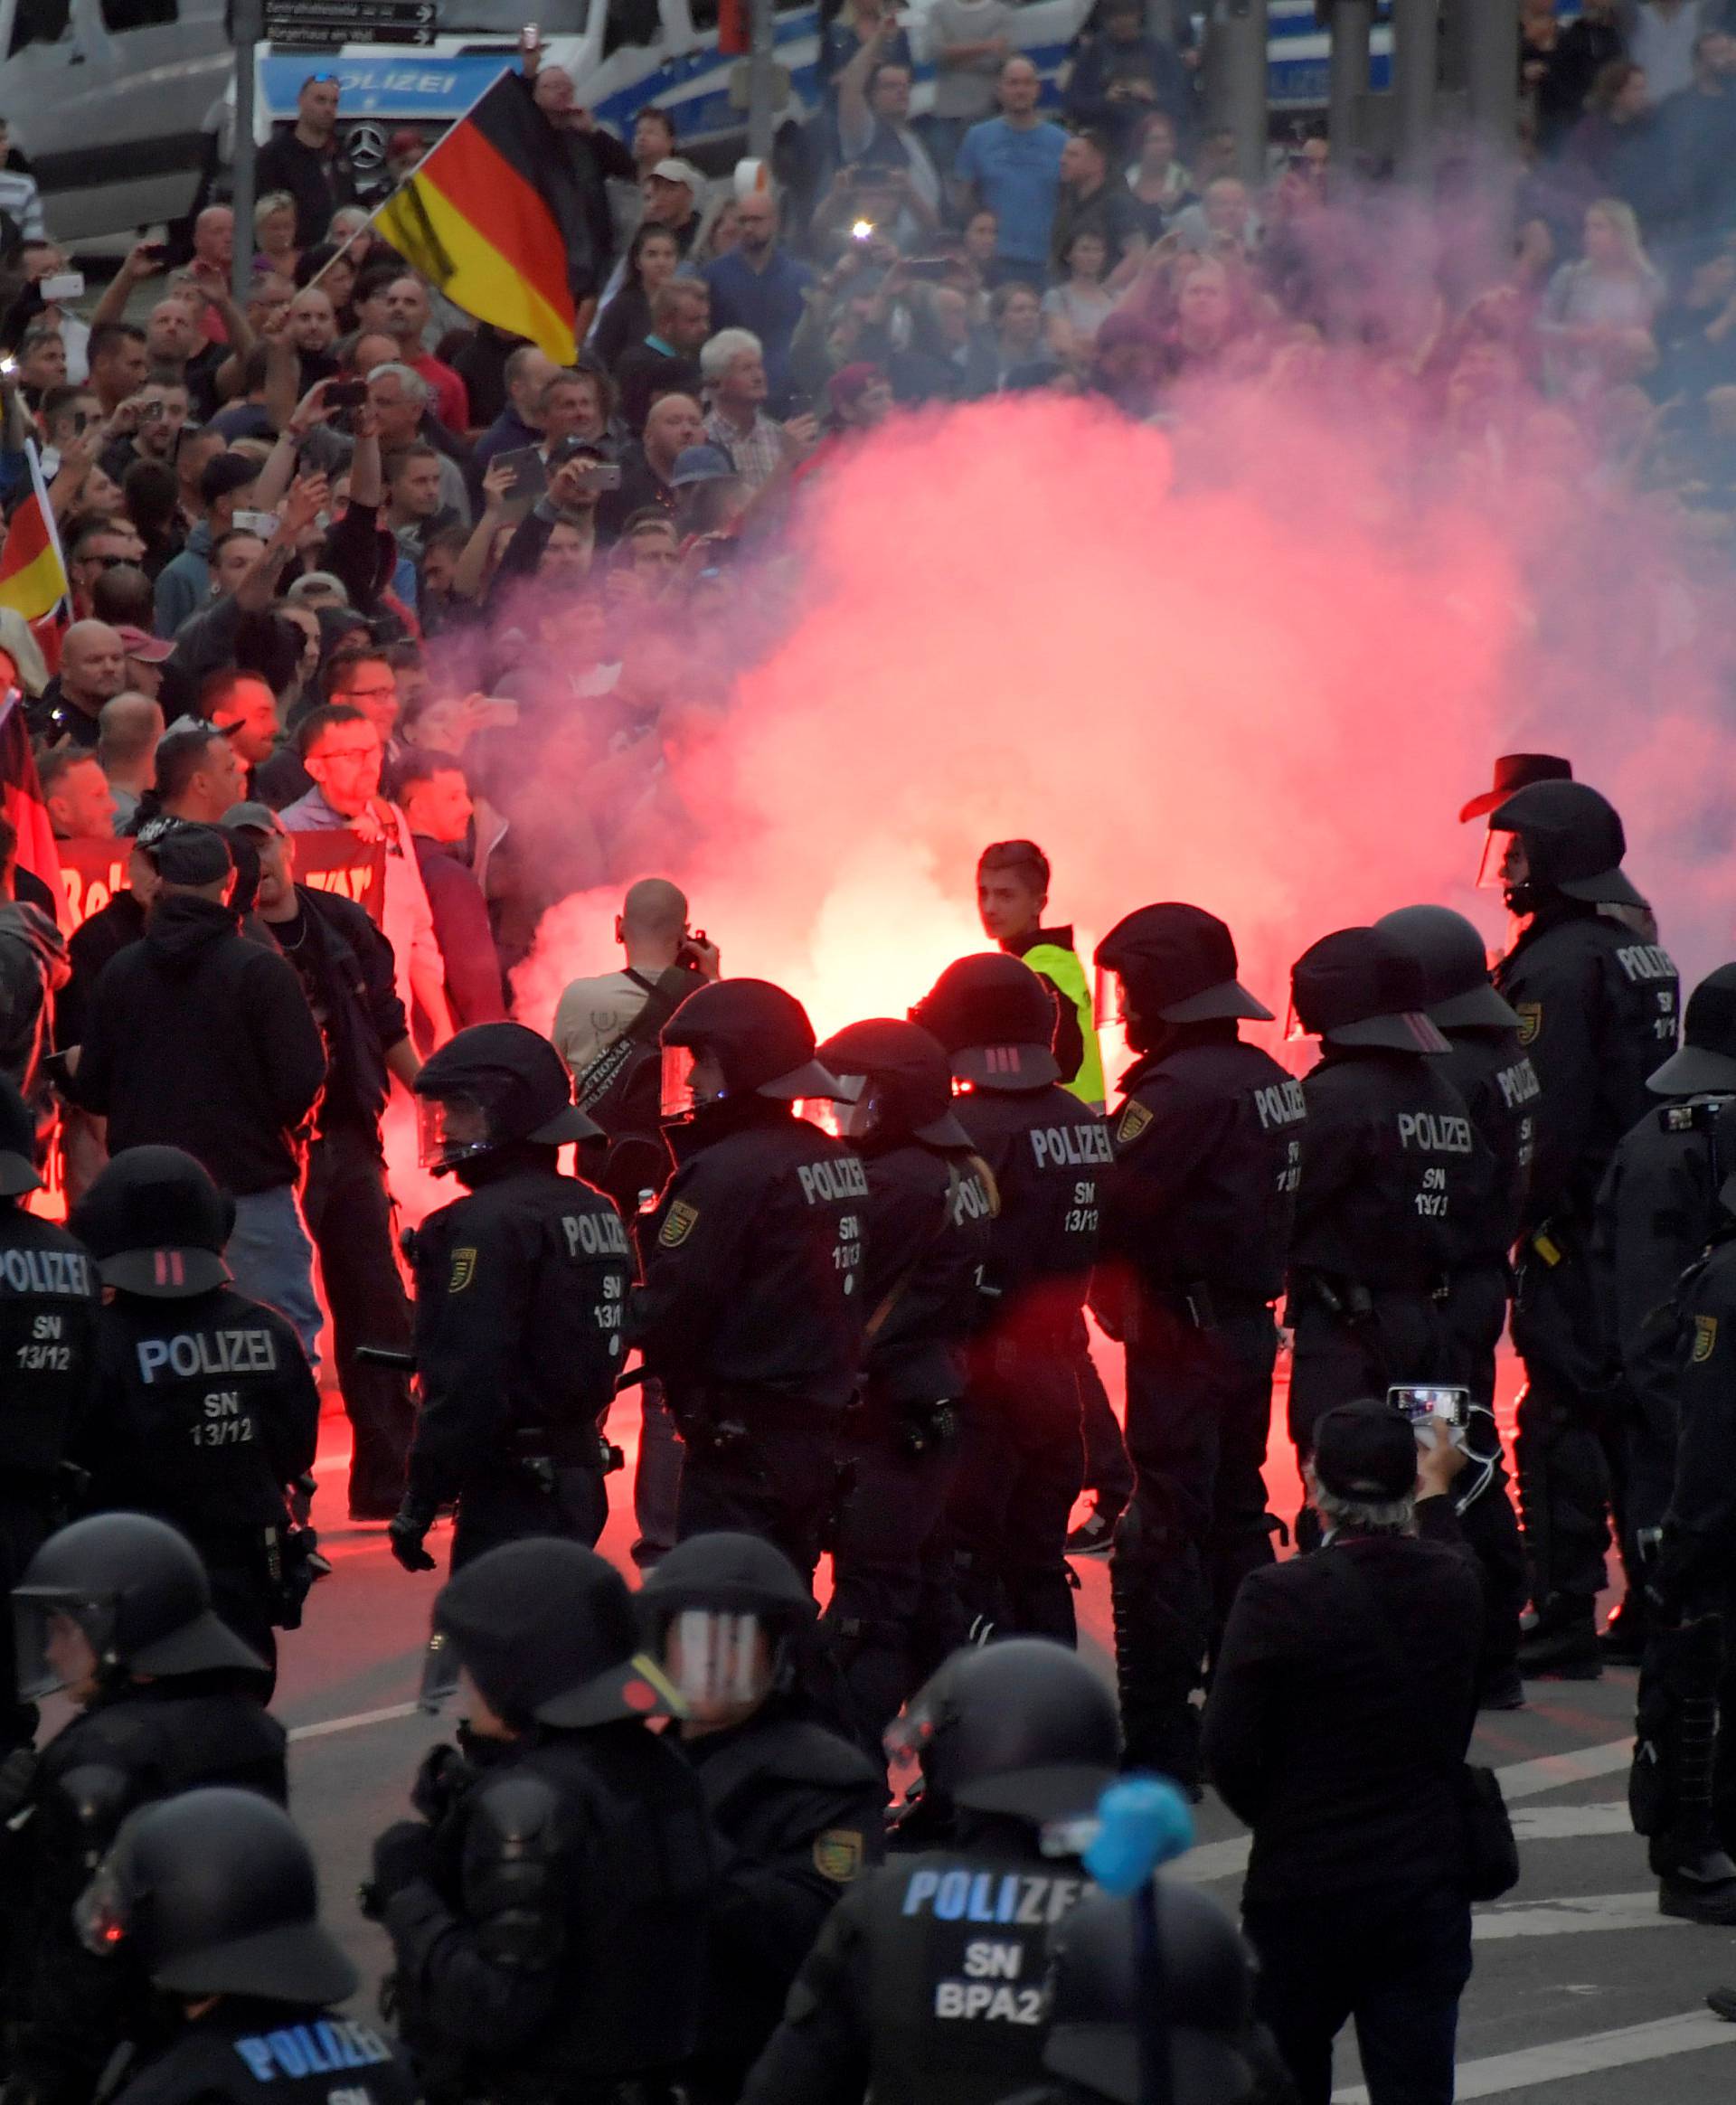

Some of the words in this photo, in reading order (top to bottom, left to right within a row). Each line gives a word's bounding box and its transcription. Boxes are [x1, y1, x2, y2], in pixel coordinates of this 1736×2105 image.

[338, 72, 457, 93] OLIZEI
[1030, 1124, 1114, 1168] POLIZEI
[1398, 1112, 1473, 1154] POLIZEI
[1073, 1181, 1096, 1204] SN
[1422, 1168, 1447, 1190] SN
[839, 1215, 858, 1241] SN
[0, 1250, 90, 1296] OLIZEI
[602, 1275, 621, 1299] SN
[32, 1316, 61, 1339] SN
[593, 1304, 622, 1328] 13/1
[16, 1345, 71, 1371] 13/12
[137, 1329, 277, 1384] POLIZEI
[203, 1391, 240, 1418] SN
[189, 1417, 253, 1446] 13/12
[963, 1943, 1023, 1980] SN
[935, 1983, 1043, 2026] BPA2
[233, 2019, 393, 2083] POLIZEI
